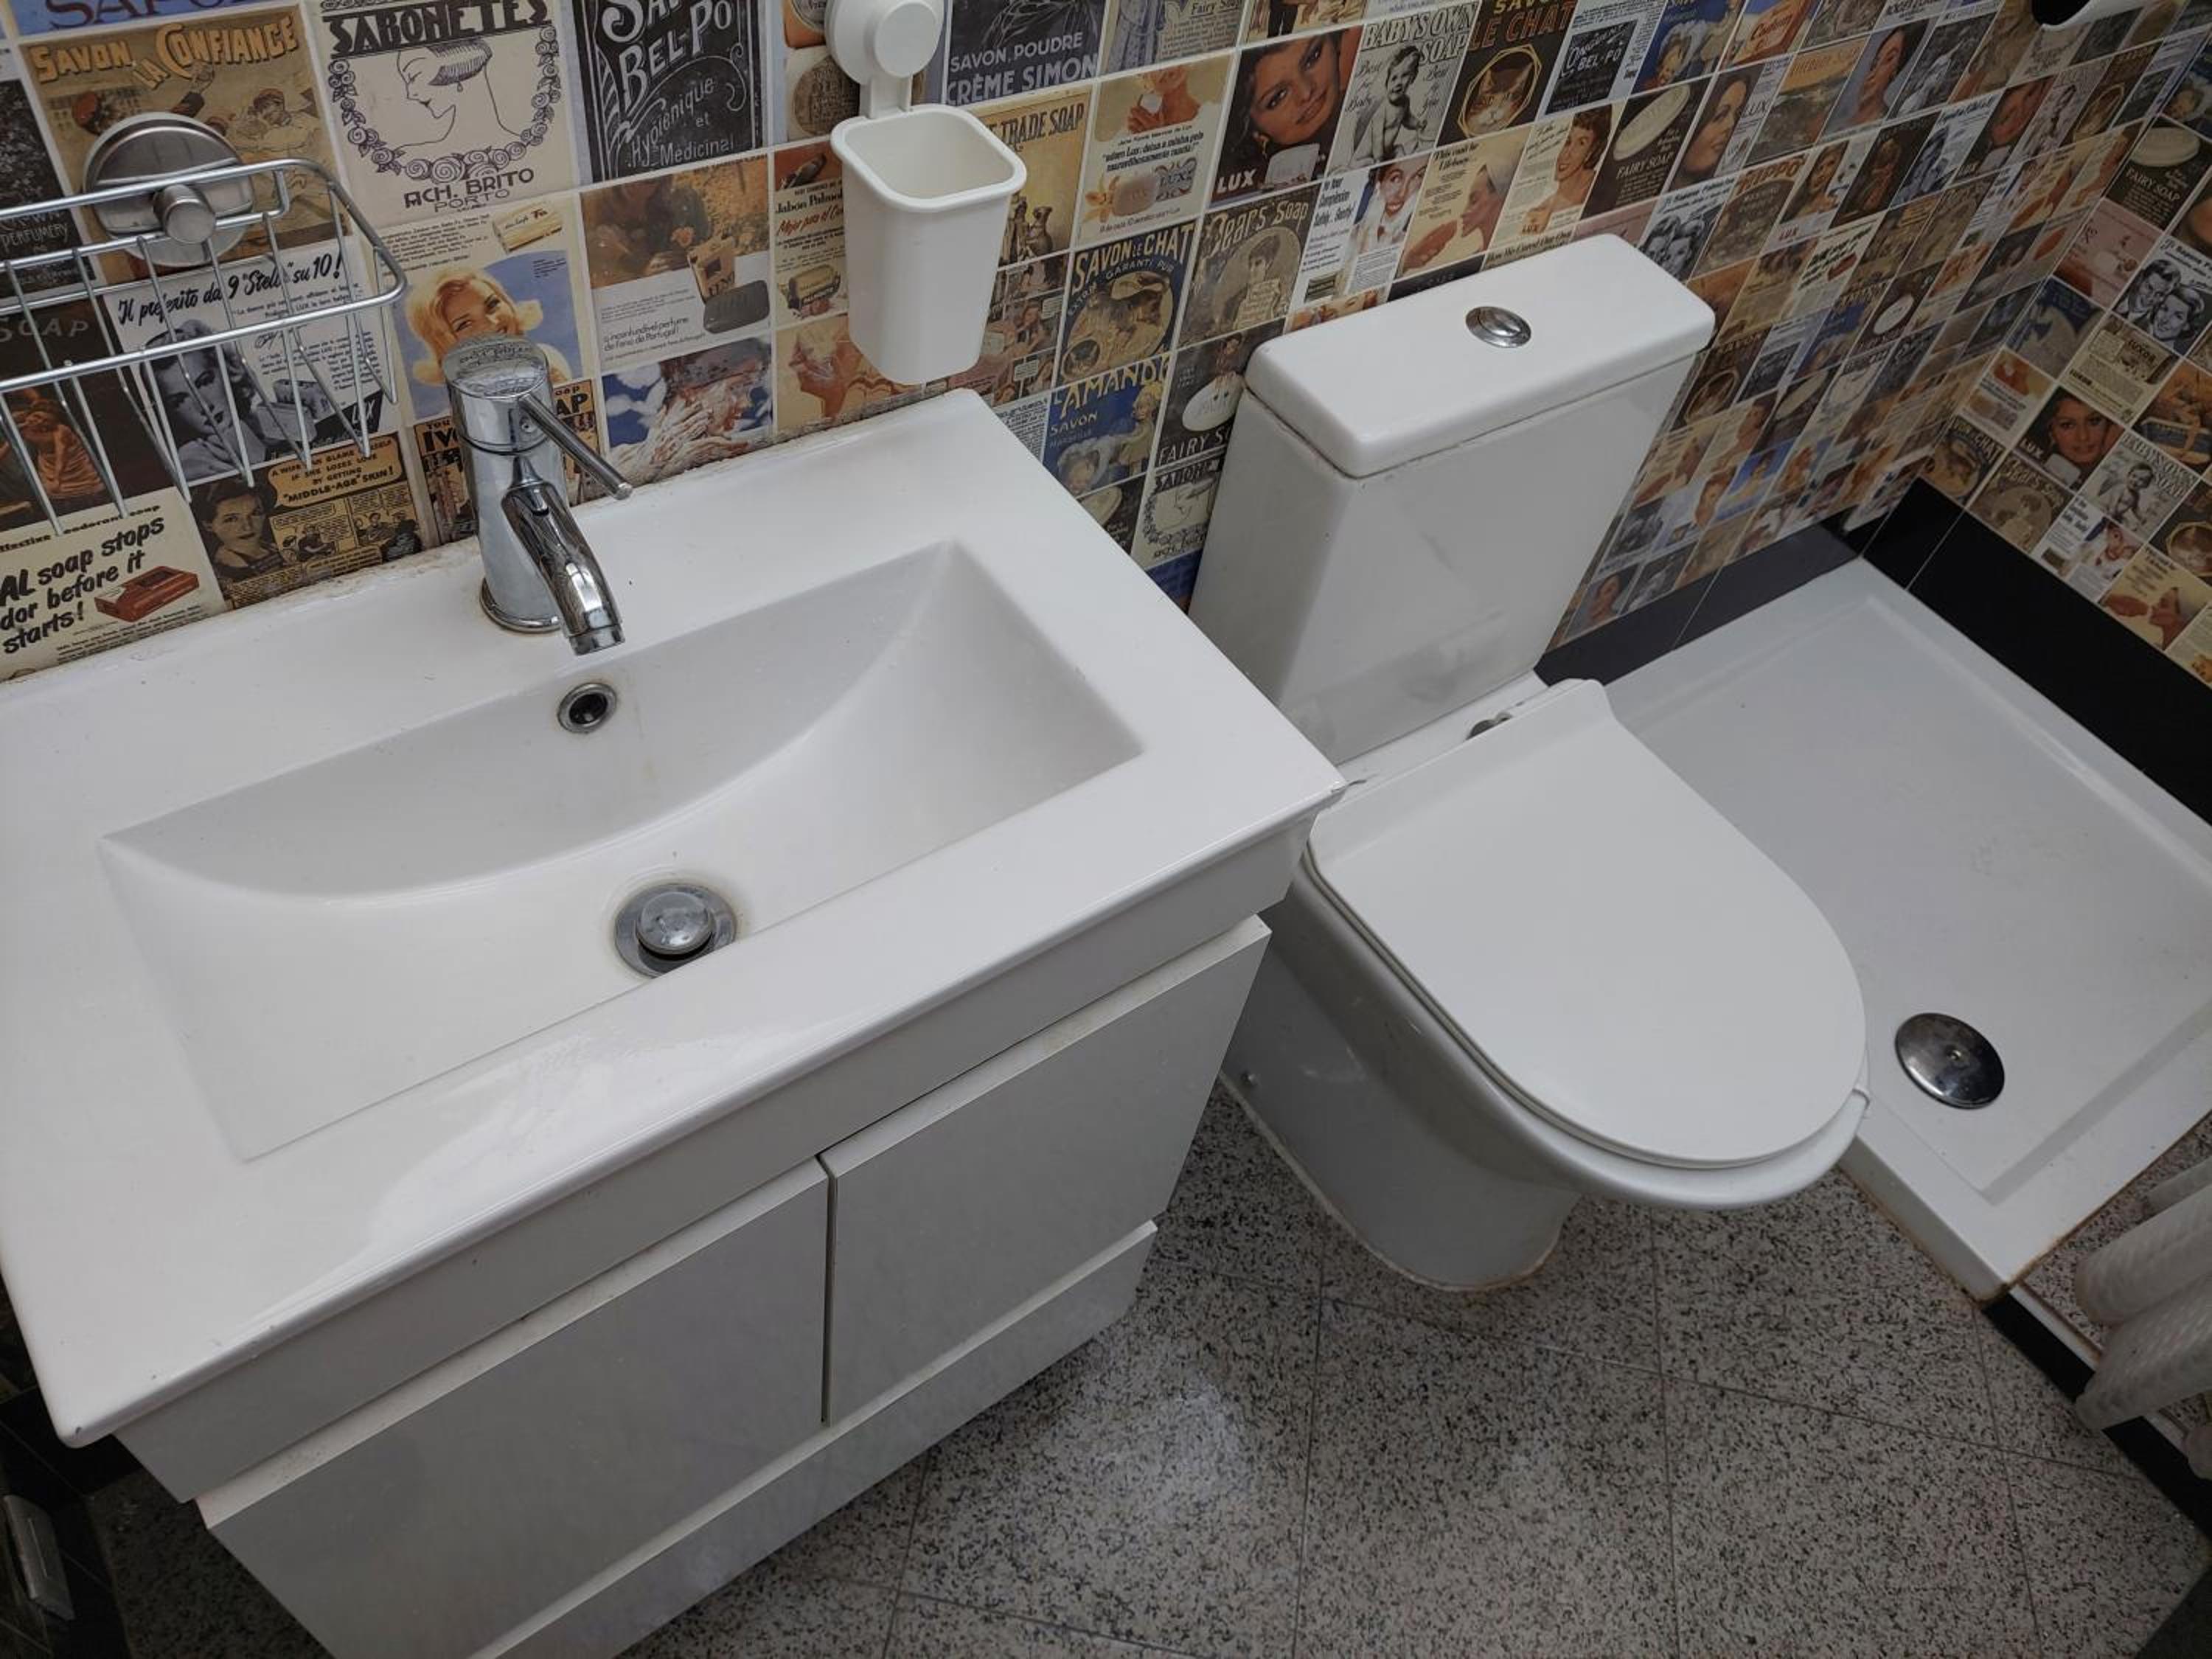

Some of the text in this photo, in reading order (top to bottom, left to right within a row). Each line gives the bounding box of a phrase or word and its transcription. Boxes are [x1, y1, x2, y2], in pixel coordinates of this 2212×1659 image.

[1430, 2, 1478, 35] OWN
[1506, 1, 1576, 42] CHAT
[28, 15, 299, 90] SAVON LA CONFIANCE
[1014, 32, 1083, 60] POUDRE
[1418, 32, 1469, 65] SOAP
[946, 53, 1099, 105] CRÈME SIMON
[695, 111, 711, 128] et
[1001, 111, 1047, 147] TRADE
[1048, 102, 1085, 136] SOAP
[466, 168, 535, 197] BRITO
[1218, 170, 1256, 194] LUX
[434, 189, 511, 214] PORTO
[1275, 199, 1309, 226] Soap
[1, 222, 69, 254] PERFUMERY
[1071, 240, 1134, 293] SAVON
[1144, 219, 1194, 265] CHAT
[1106, 258, 1152, 279] GARANTI
[1157, 260, 1175, 273] PUR
[118, 299, 134, 325] Il
[204, 286, 224, 302] da
[228, 275, 240, 299] 9
[293, 268, 310, 285] su
[1051, 410, 1098, 437] SAVON
[326, 449, 355, 462] BLAME
[1158, 434, 1208, 466] FAIRY
[2019, 438, 2045, 459] LUX
[313, 467, 363, 486] BY GETTING
[326, 460, 352, 472] LOSES
[284, 465, 394, 503] "MIDDLE-AGE" SKIN!
[38, 549, 94, 586] soap
[101, 516, 165, 557] stops
[47, 566, 119, 610] before
[127, 549, 146, 574] it
[2, 601, 85, 654] starts!
